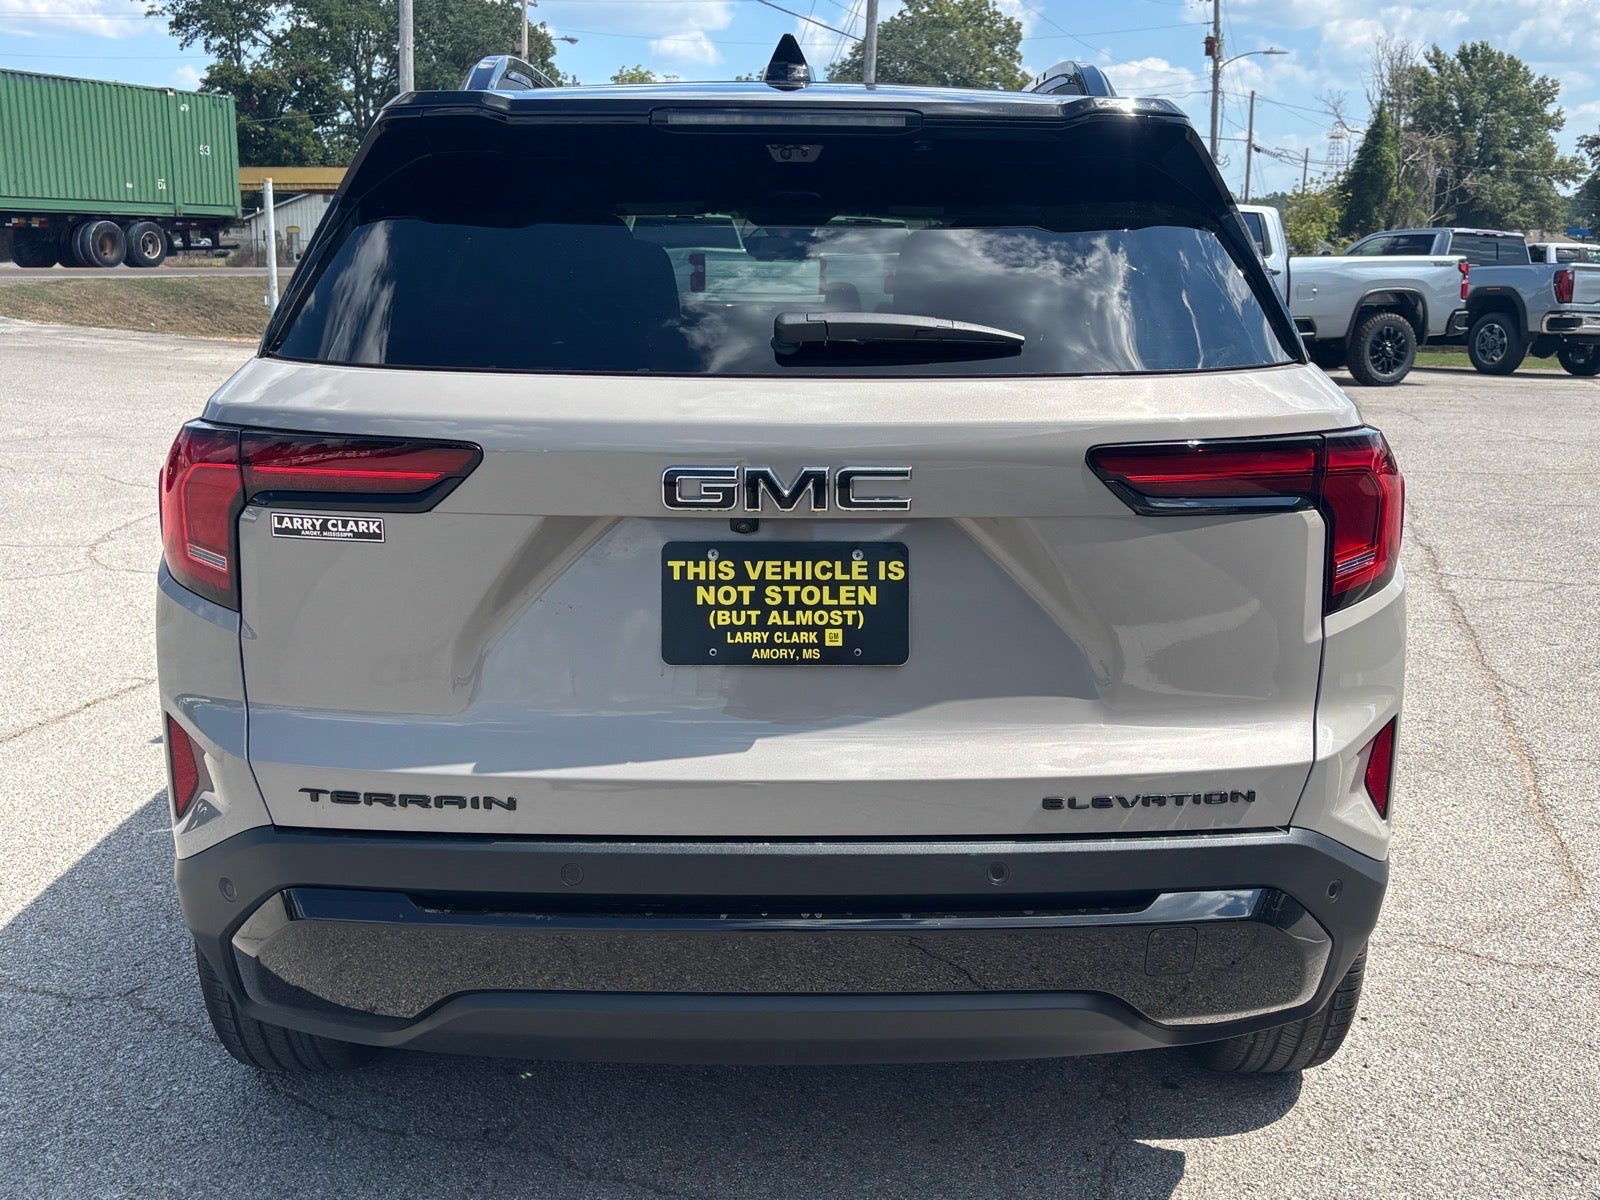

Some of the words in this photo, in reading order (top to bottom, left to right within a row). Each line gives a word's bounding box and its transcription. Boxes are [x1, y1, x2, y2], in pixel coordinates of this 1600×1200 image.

[199, 144, 210, 156] 53
[662, 465, 912, 512] GMC
[273, 516, 324, 531] LARRY
[327, 519, 382, 533] CLARK
[667, 560, 736, 581] THIS
[744, 560, 869, 581] VEHICLE
[878, 560, 906, 581] IS
[696, 585, 755, 606] NOT
[764, 585, 878, 606] STOLEN
[708, 610, 761, 629] (BUT
[767, 610, 865, 629] ALMOST)
[727, 631, 770, 644] LARRY
[773, 631, 819, 644] CLARK
[751, 648, 799, 661] AMORY,
[802, 648, 821, 659] MS
[298, 787, 518, 812] TERRAIN
[1041, 789, 1257, 811] ELEVATION
